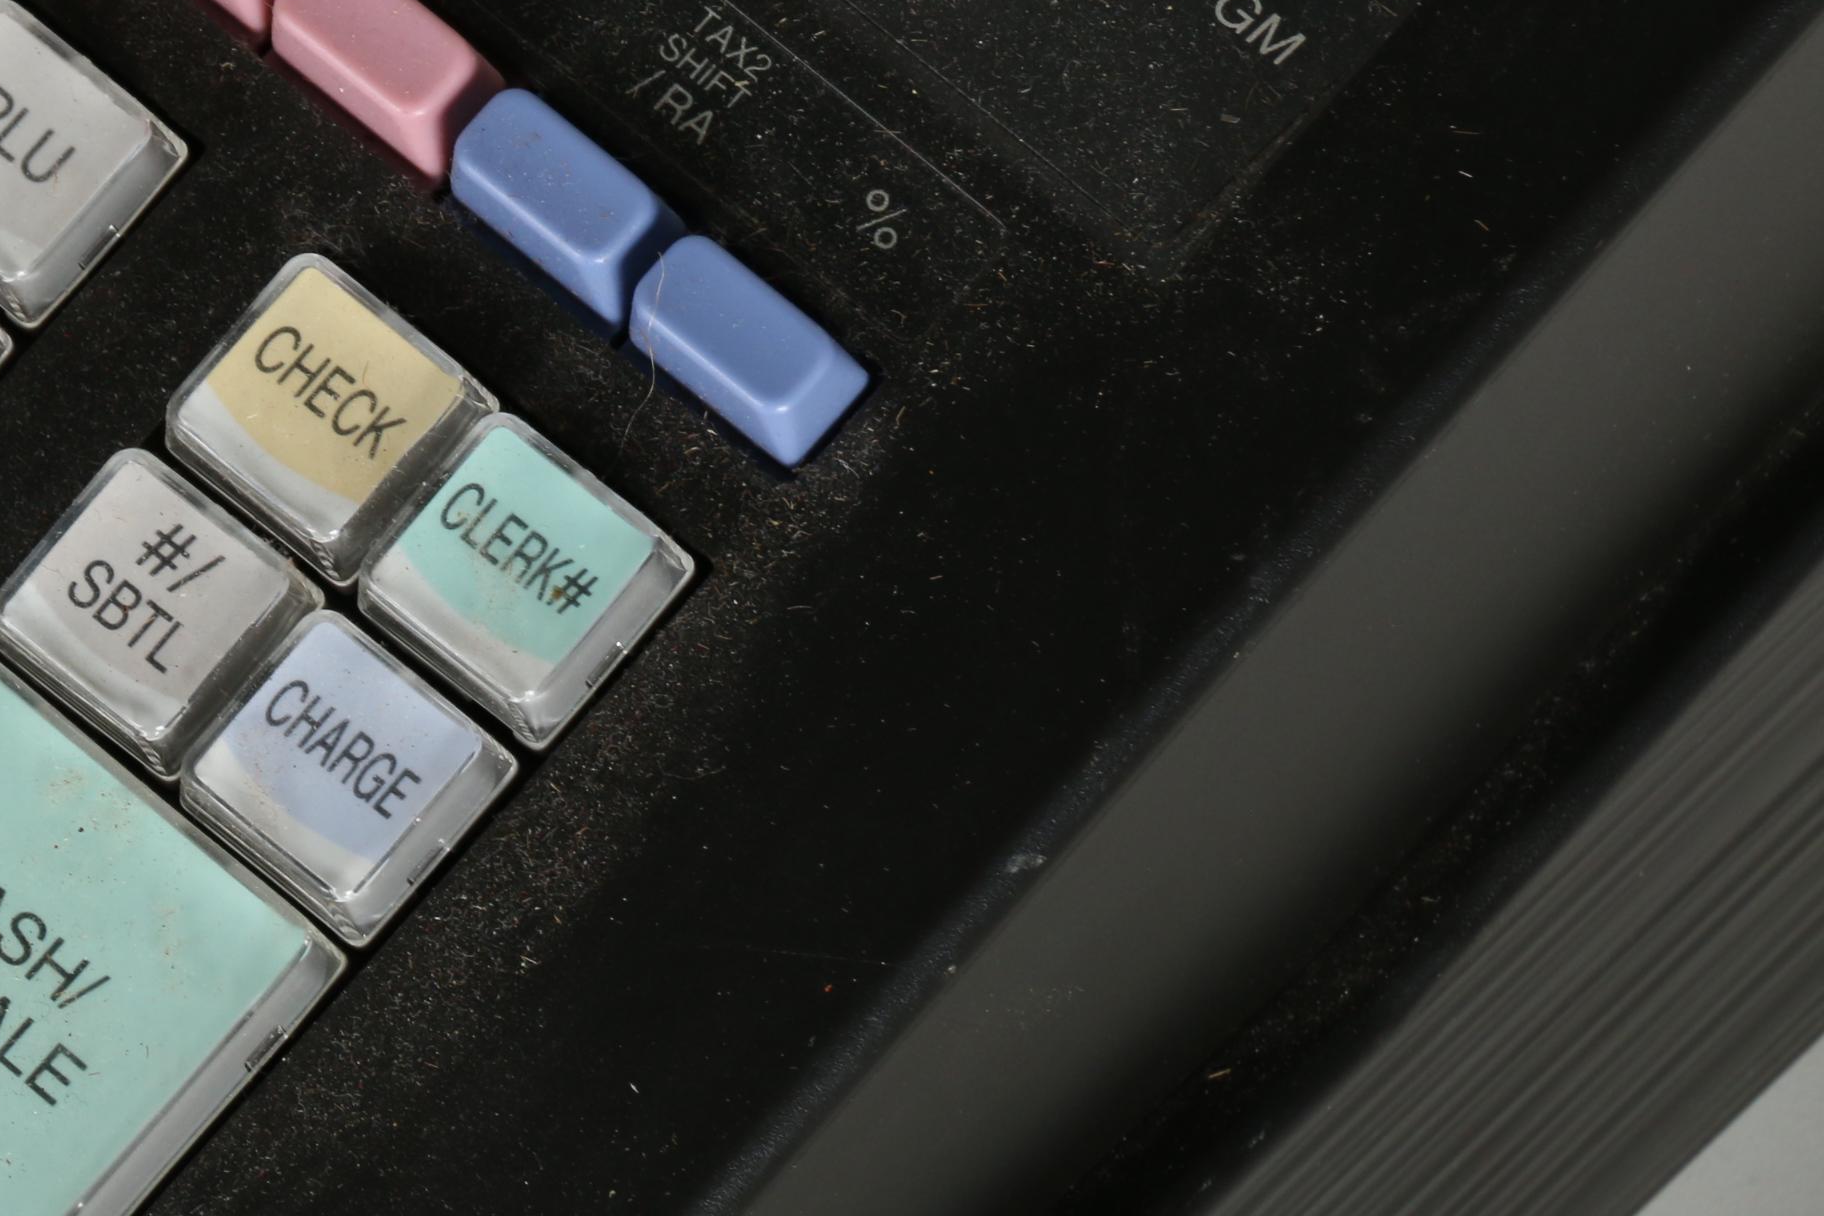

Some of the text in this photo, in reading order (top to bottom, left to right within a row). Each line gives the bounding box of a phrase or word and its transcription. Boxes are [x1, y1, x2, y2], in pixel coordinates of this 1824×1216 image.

[659, 33, 752, 109] SHIFT
[690, 5, 773, 83] TAX2
[856, 189, 907, 250] %
[254, 325, 407, 460] CHECK
[135, 523, 226, 594] #/
[439, 482, 599, 615] CLERK#
[68, 560, 186, 674] SBTL
[265, 680, 421, 819] CHARGE
